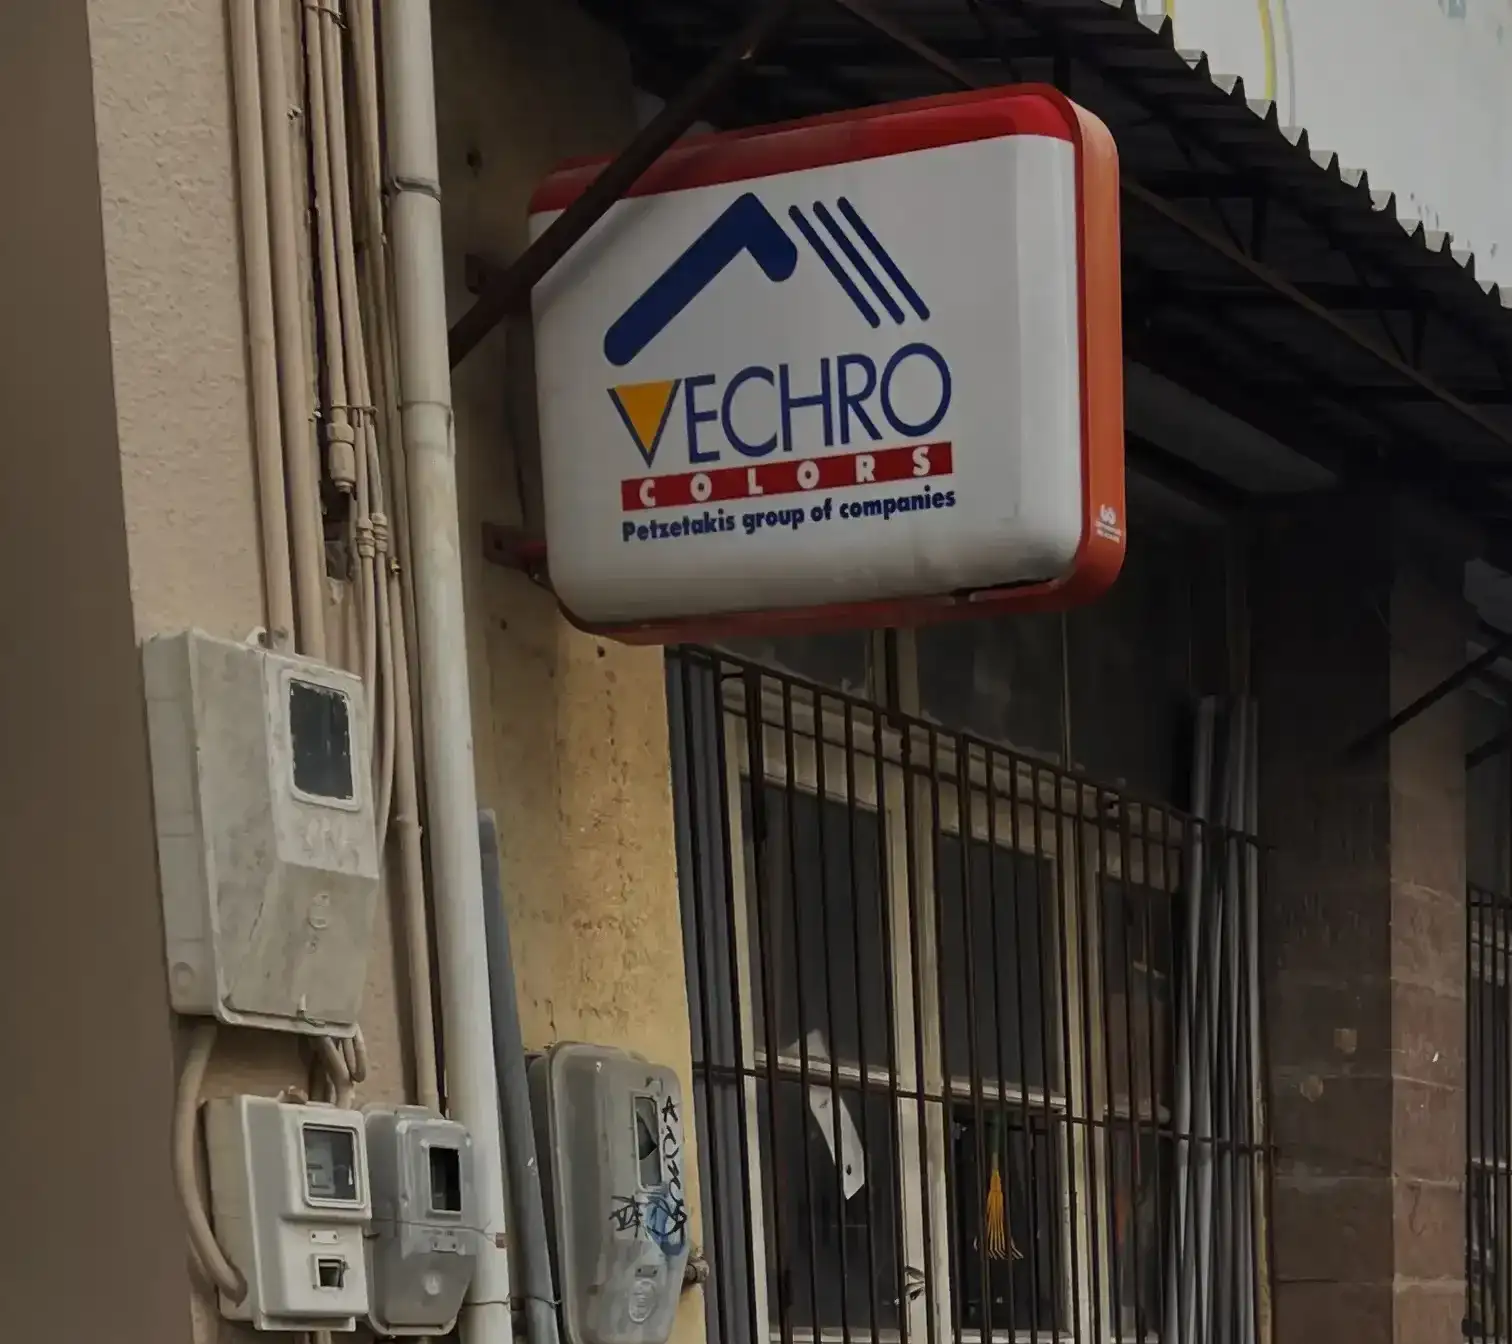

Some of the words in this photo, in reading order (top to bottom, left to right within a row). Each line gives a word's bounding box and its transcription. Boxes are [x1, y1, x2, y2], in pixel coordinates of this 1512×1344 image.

[606, 342, 952, 468] VECHRO
[638, 446, 932, 508] COLORS
[622, 508, 735, 541] Petzetakis
[742, 503, 804, 534] group
[810, 498, 833, 521] of
[839, 485, 956, 520] companies
